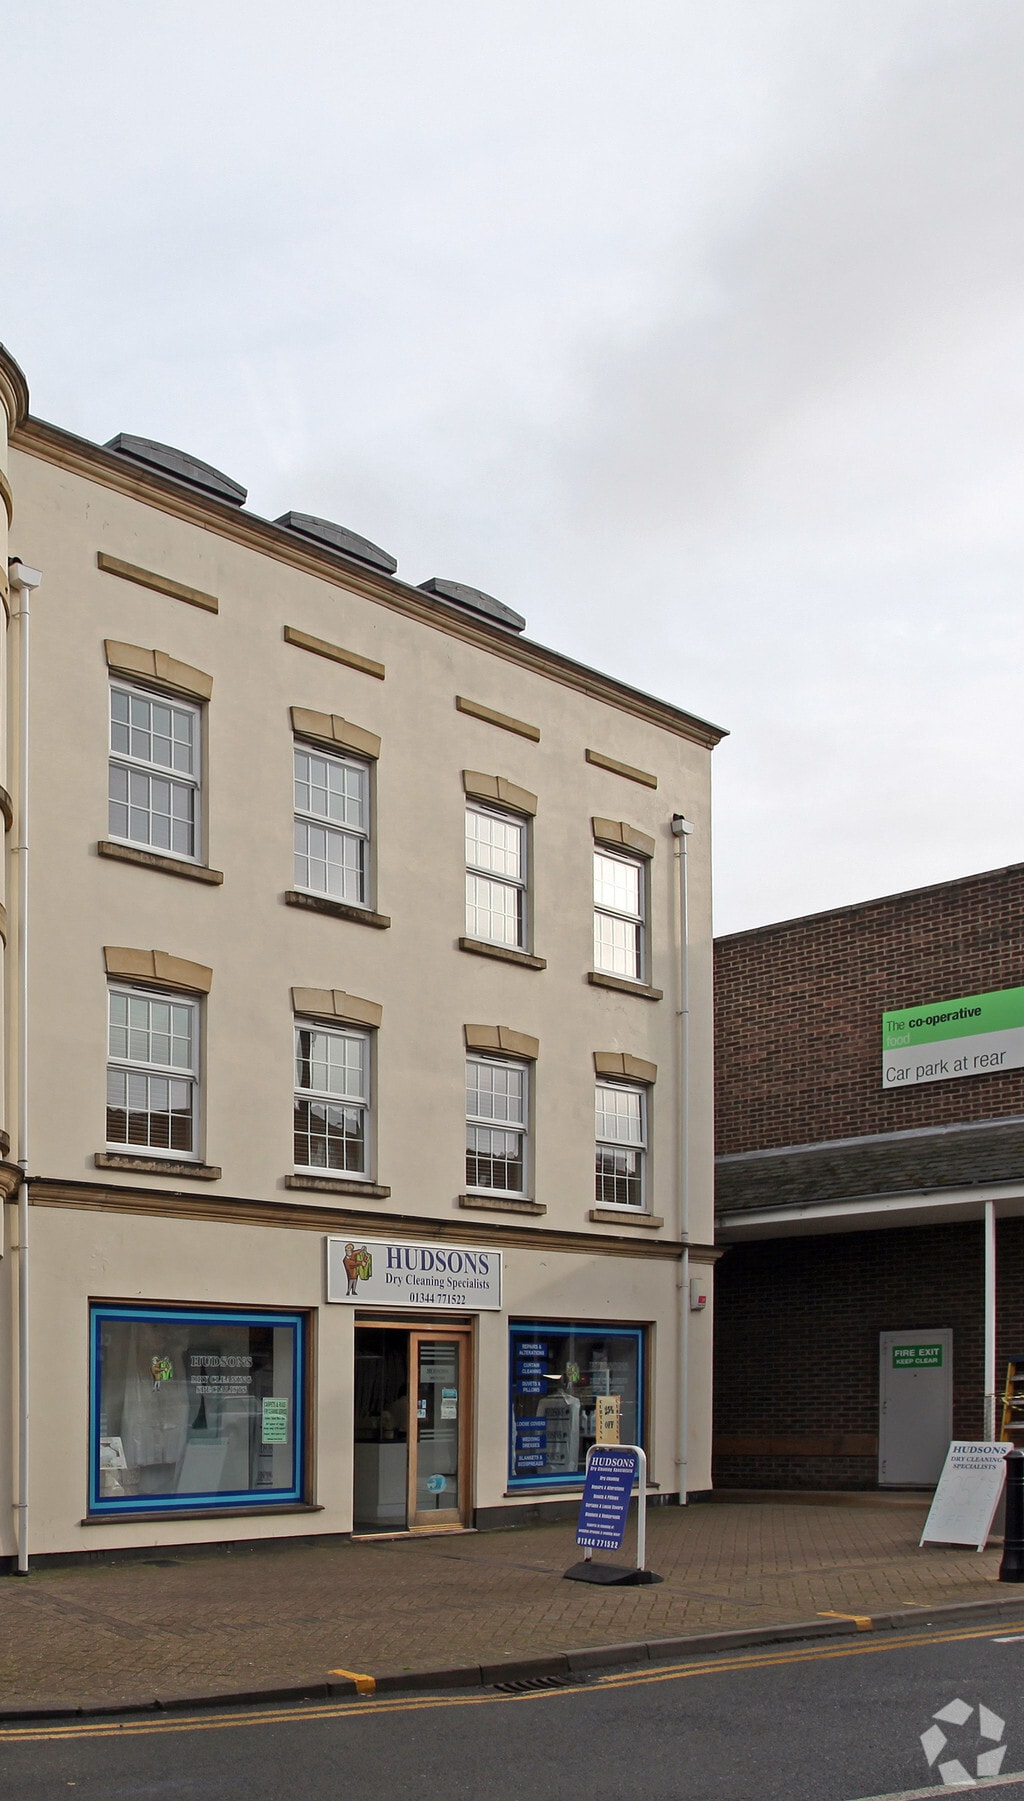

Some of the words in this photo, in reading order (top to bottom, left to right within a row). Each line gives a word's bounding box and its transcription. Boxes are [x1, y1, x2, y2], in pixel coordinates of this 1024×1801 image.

[886, 1021, 905, 1032] The
[908, 1007, 982, 1028] co-operative
[887, 1033, 910, 1047] food
[886, 1066, 911, 1082] Car
[916, 1060, 949, 1080] park
[954, 1056, 968, 1072] at
[974, 1051, 1006, 1068] rear
[386, 1246, 490, 1276] HUDSONS
[386, 1272, 402, 1287] Dry
[406, 1274, 444, 1288] Cleaning
[446, 1276, 490, 1290] Specialists
[410, 1292, 434, 1303] 01344
[438, 1294, 466, 1304] 771522
[894, 1348, 916, 1358] FIRE
[918, 1348, 940, 1356] EXIT
[190, 1356, 253, 1368] HUDSONS
[191, 1375, 209, 1384] DRY
[210, 1375, 252, 1384] CLEANING
[604, 1420, 614, 1429] OFF
[952, 1446, 1007, 1454] HUDSONS
[591, 1457, 635, 1468] HUDSONS
